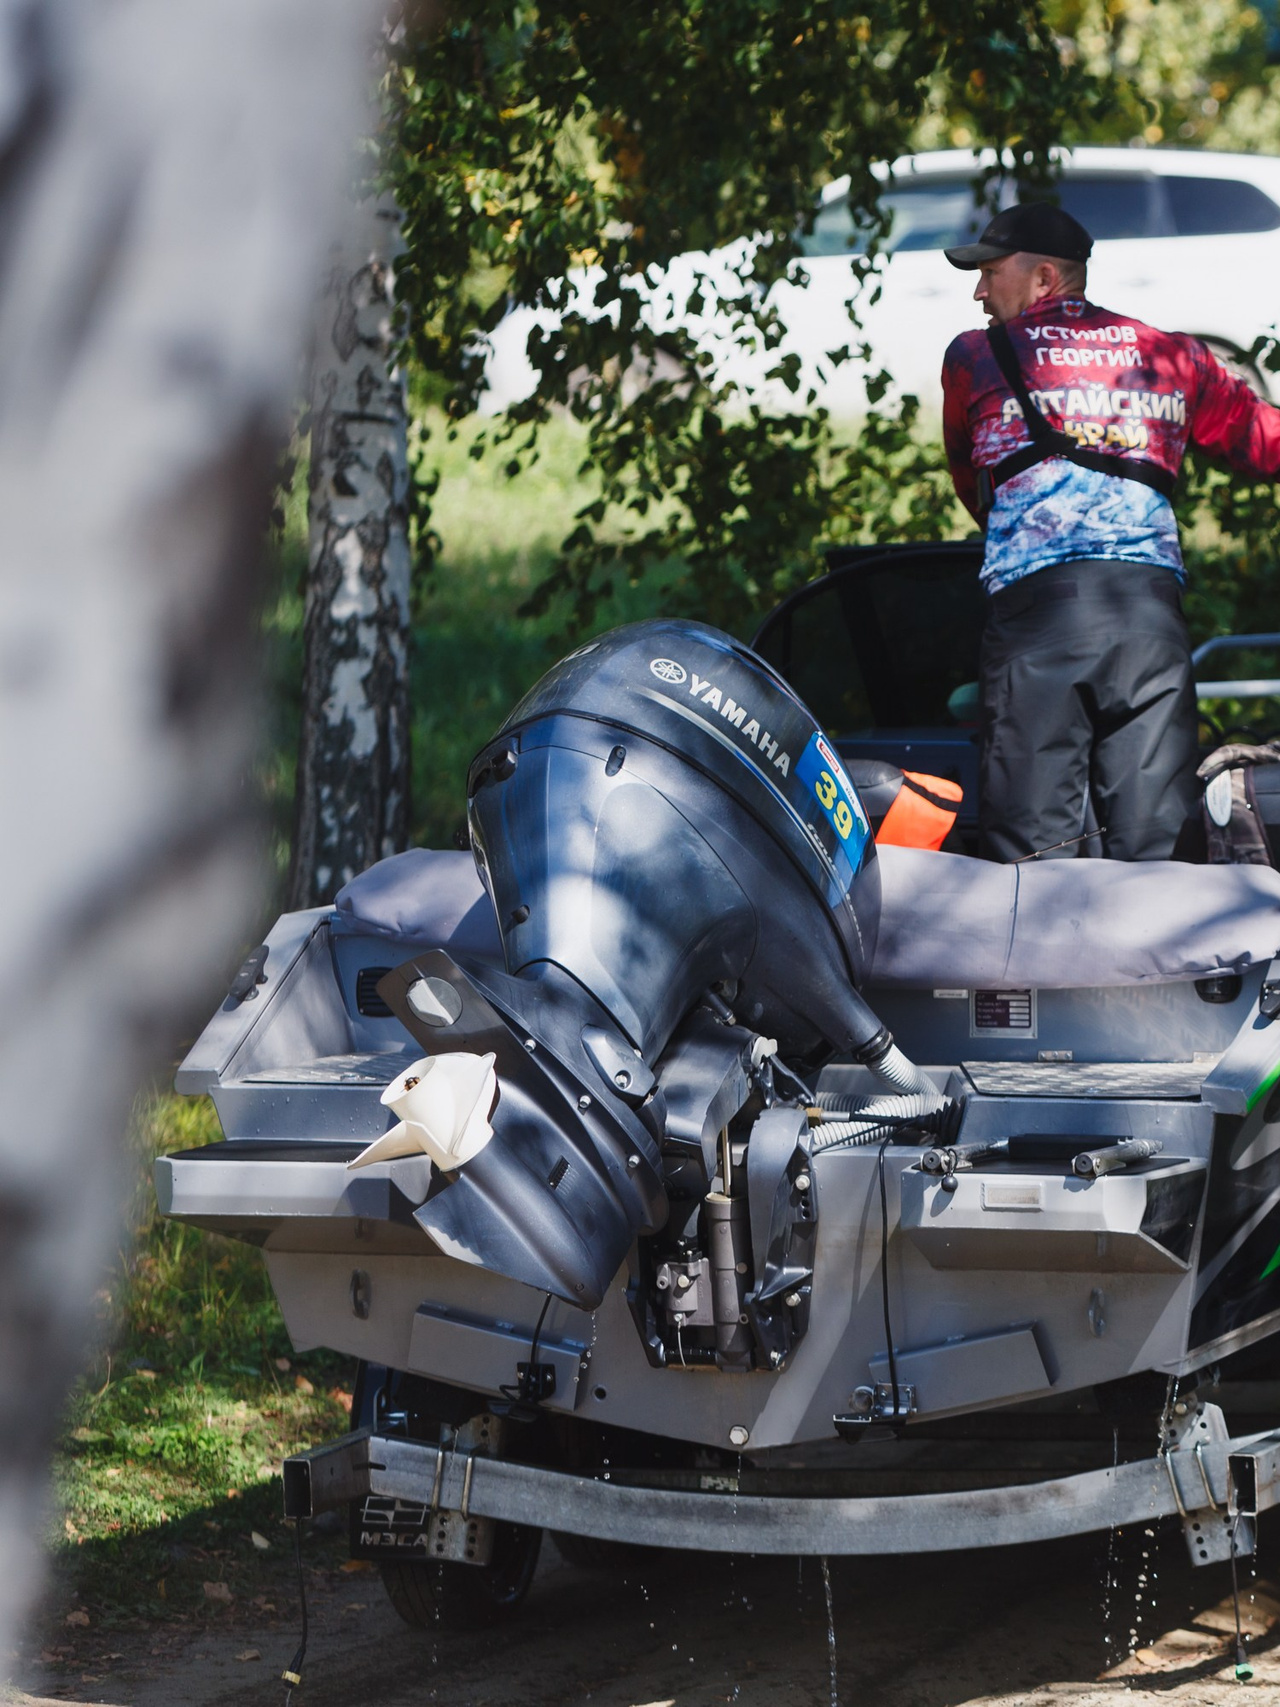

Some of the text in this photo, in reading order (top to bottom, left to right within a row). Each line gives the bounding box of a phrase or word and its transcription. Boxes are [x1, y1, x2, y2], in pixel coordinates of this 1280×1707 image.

[1035, 345, 1143, 367] ГЕОРГИЙ
[688, 673, 791, 778] YAMAHA
[815, 771, 853, 840] 39
